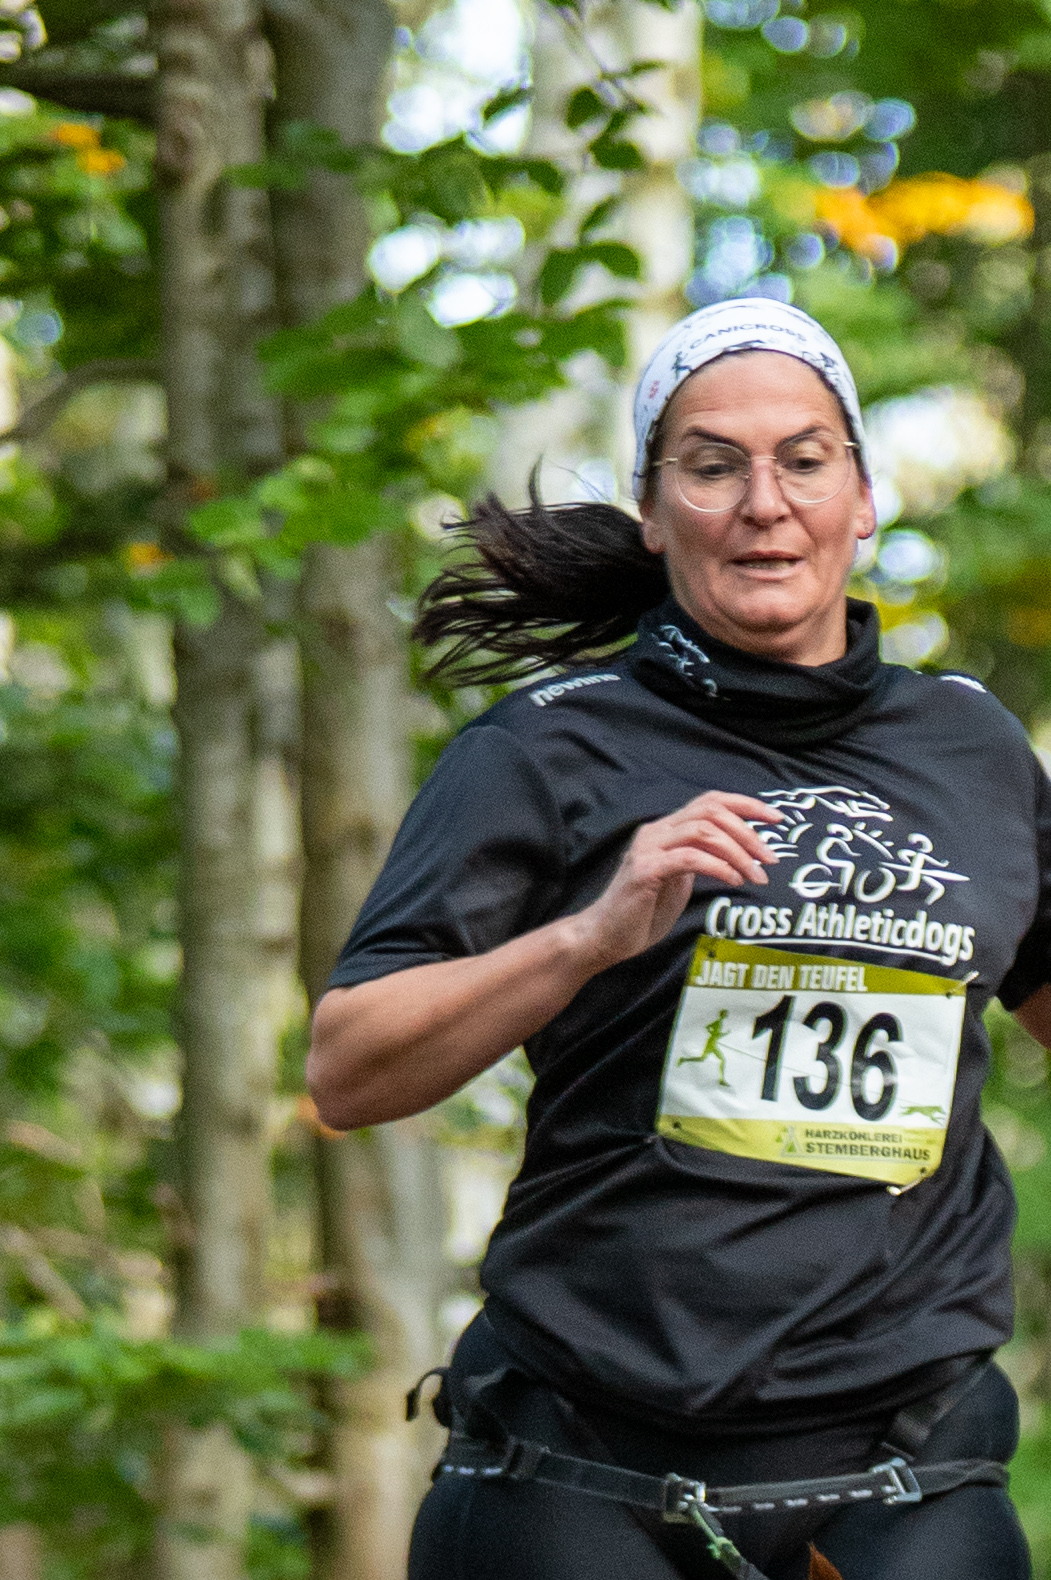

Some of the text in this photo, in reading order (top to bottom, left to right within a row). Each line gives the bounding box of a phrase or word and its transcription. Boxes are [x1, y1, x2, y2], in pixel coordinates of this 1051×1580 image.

[690, 323, 807, 350] CANICROSS
[705, 897, 975, 966] Cross Athleticdogs
[696, 961, 868, 992] JAGT DEN TEUFEL
[752, 995, 903, 1121] 136
[805, 1142, 931, 1161] STEMBERGHAUS
